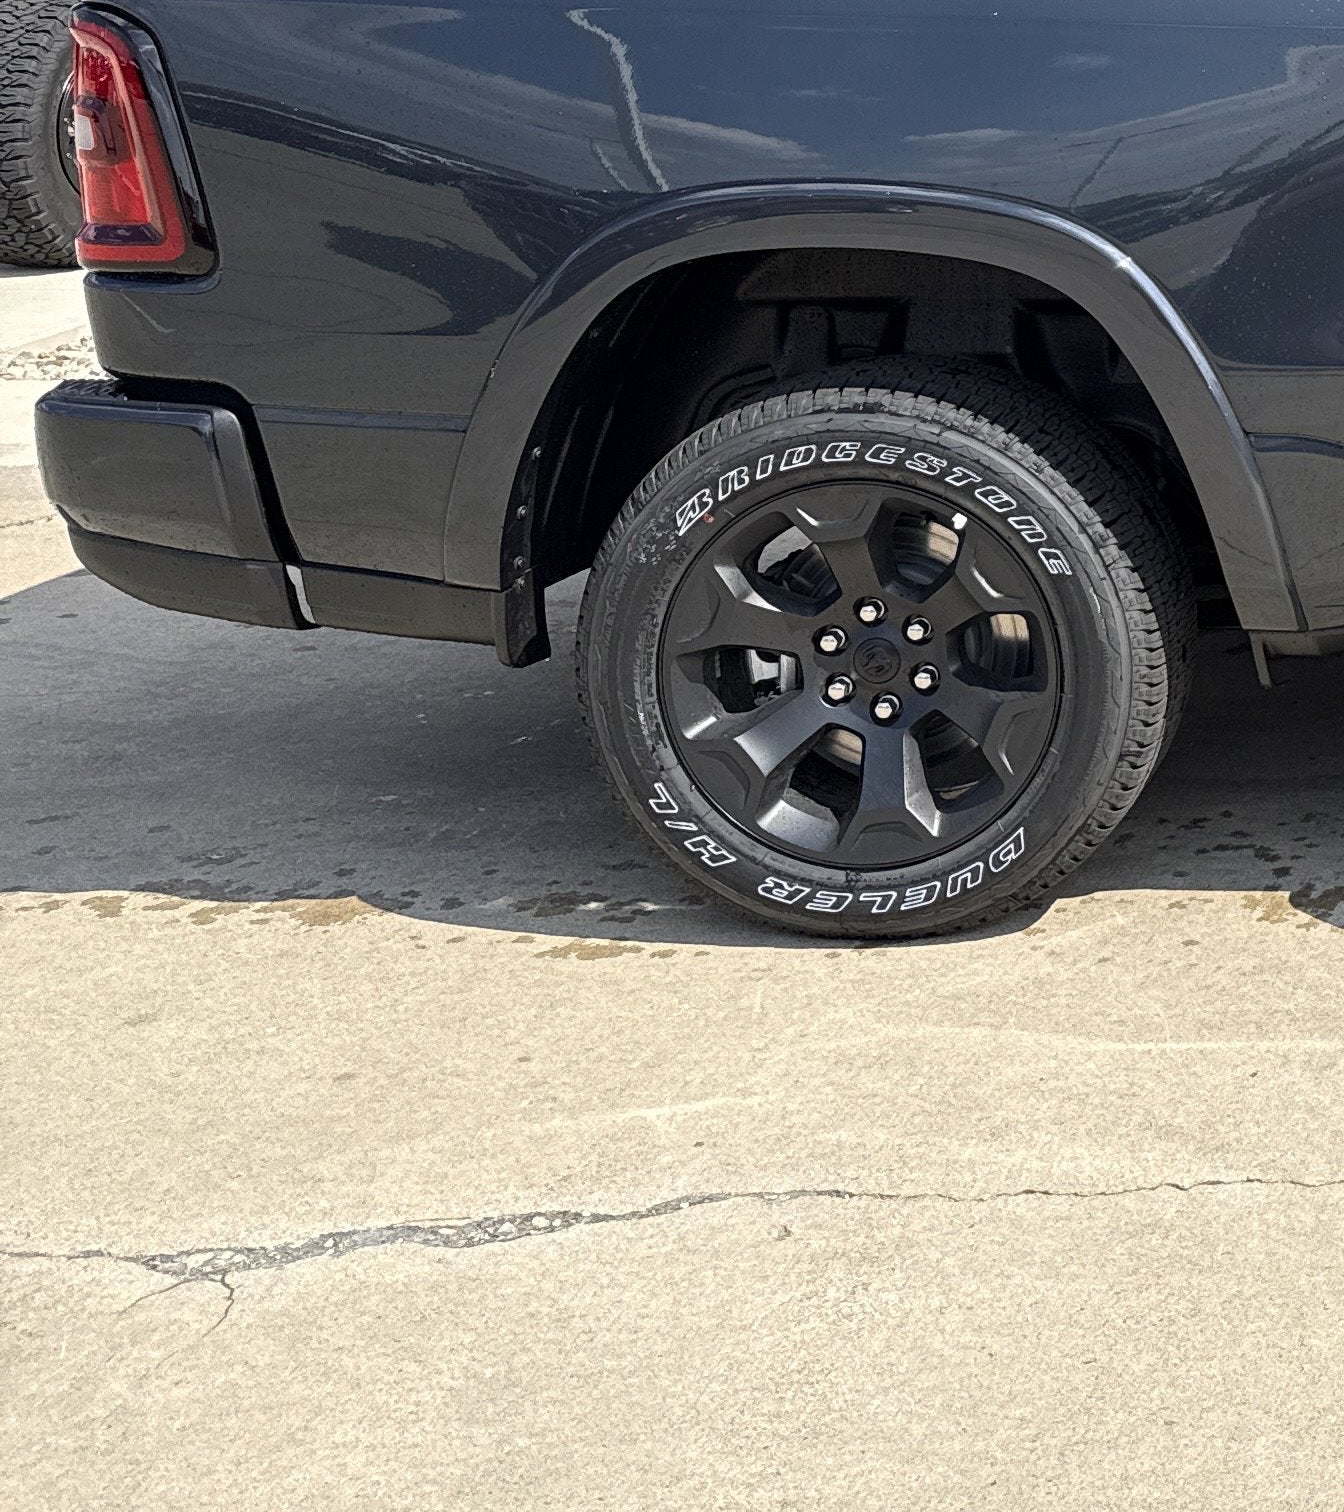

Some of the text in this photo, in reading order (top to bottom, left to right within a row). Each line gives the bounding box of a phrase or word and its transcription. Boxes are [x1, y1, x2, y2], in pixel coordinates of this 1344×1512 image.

[675, 440, 1073, 577] BRIDGESTONE
[647, 781, 1026, 914] DUELER H/L
